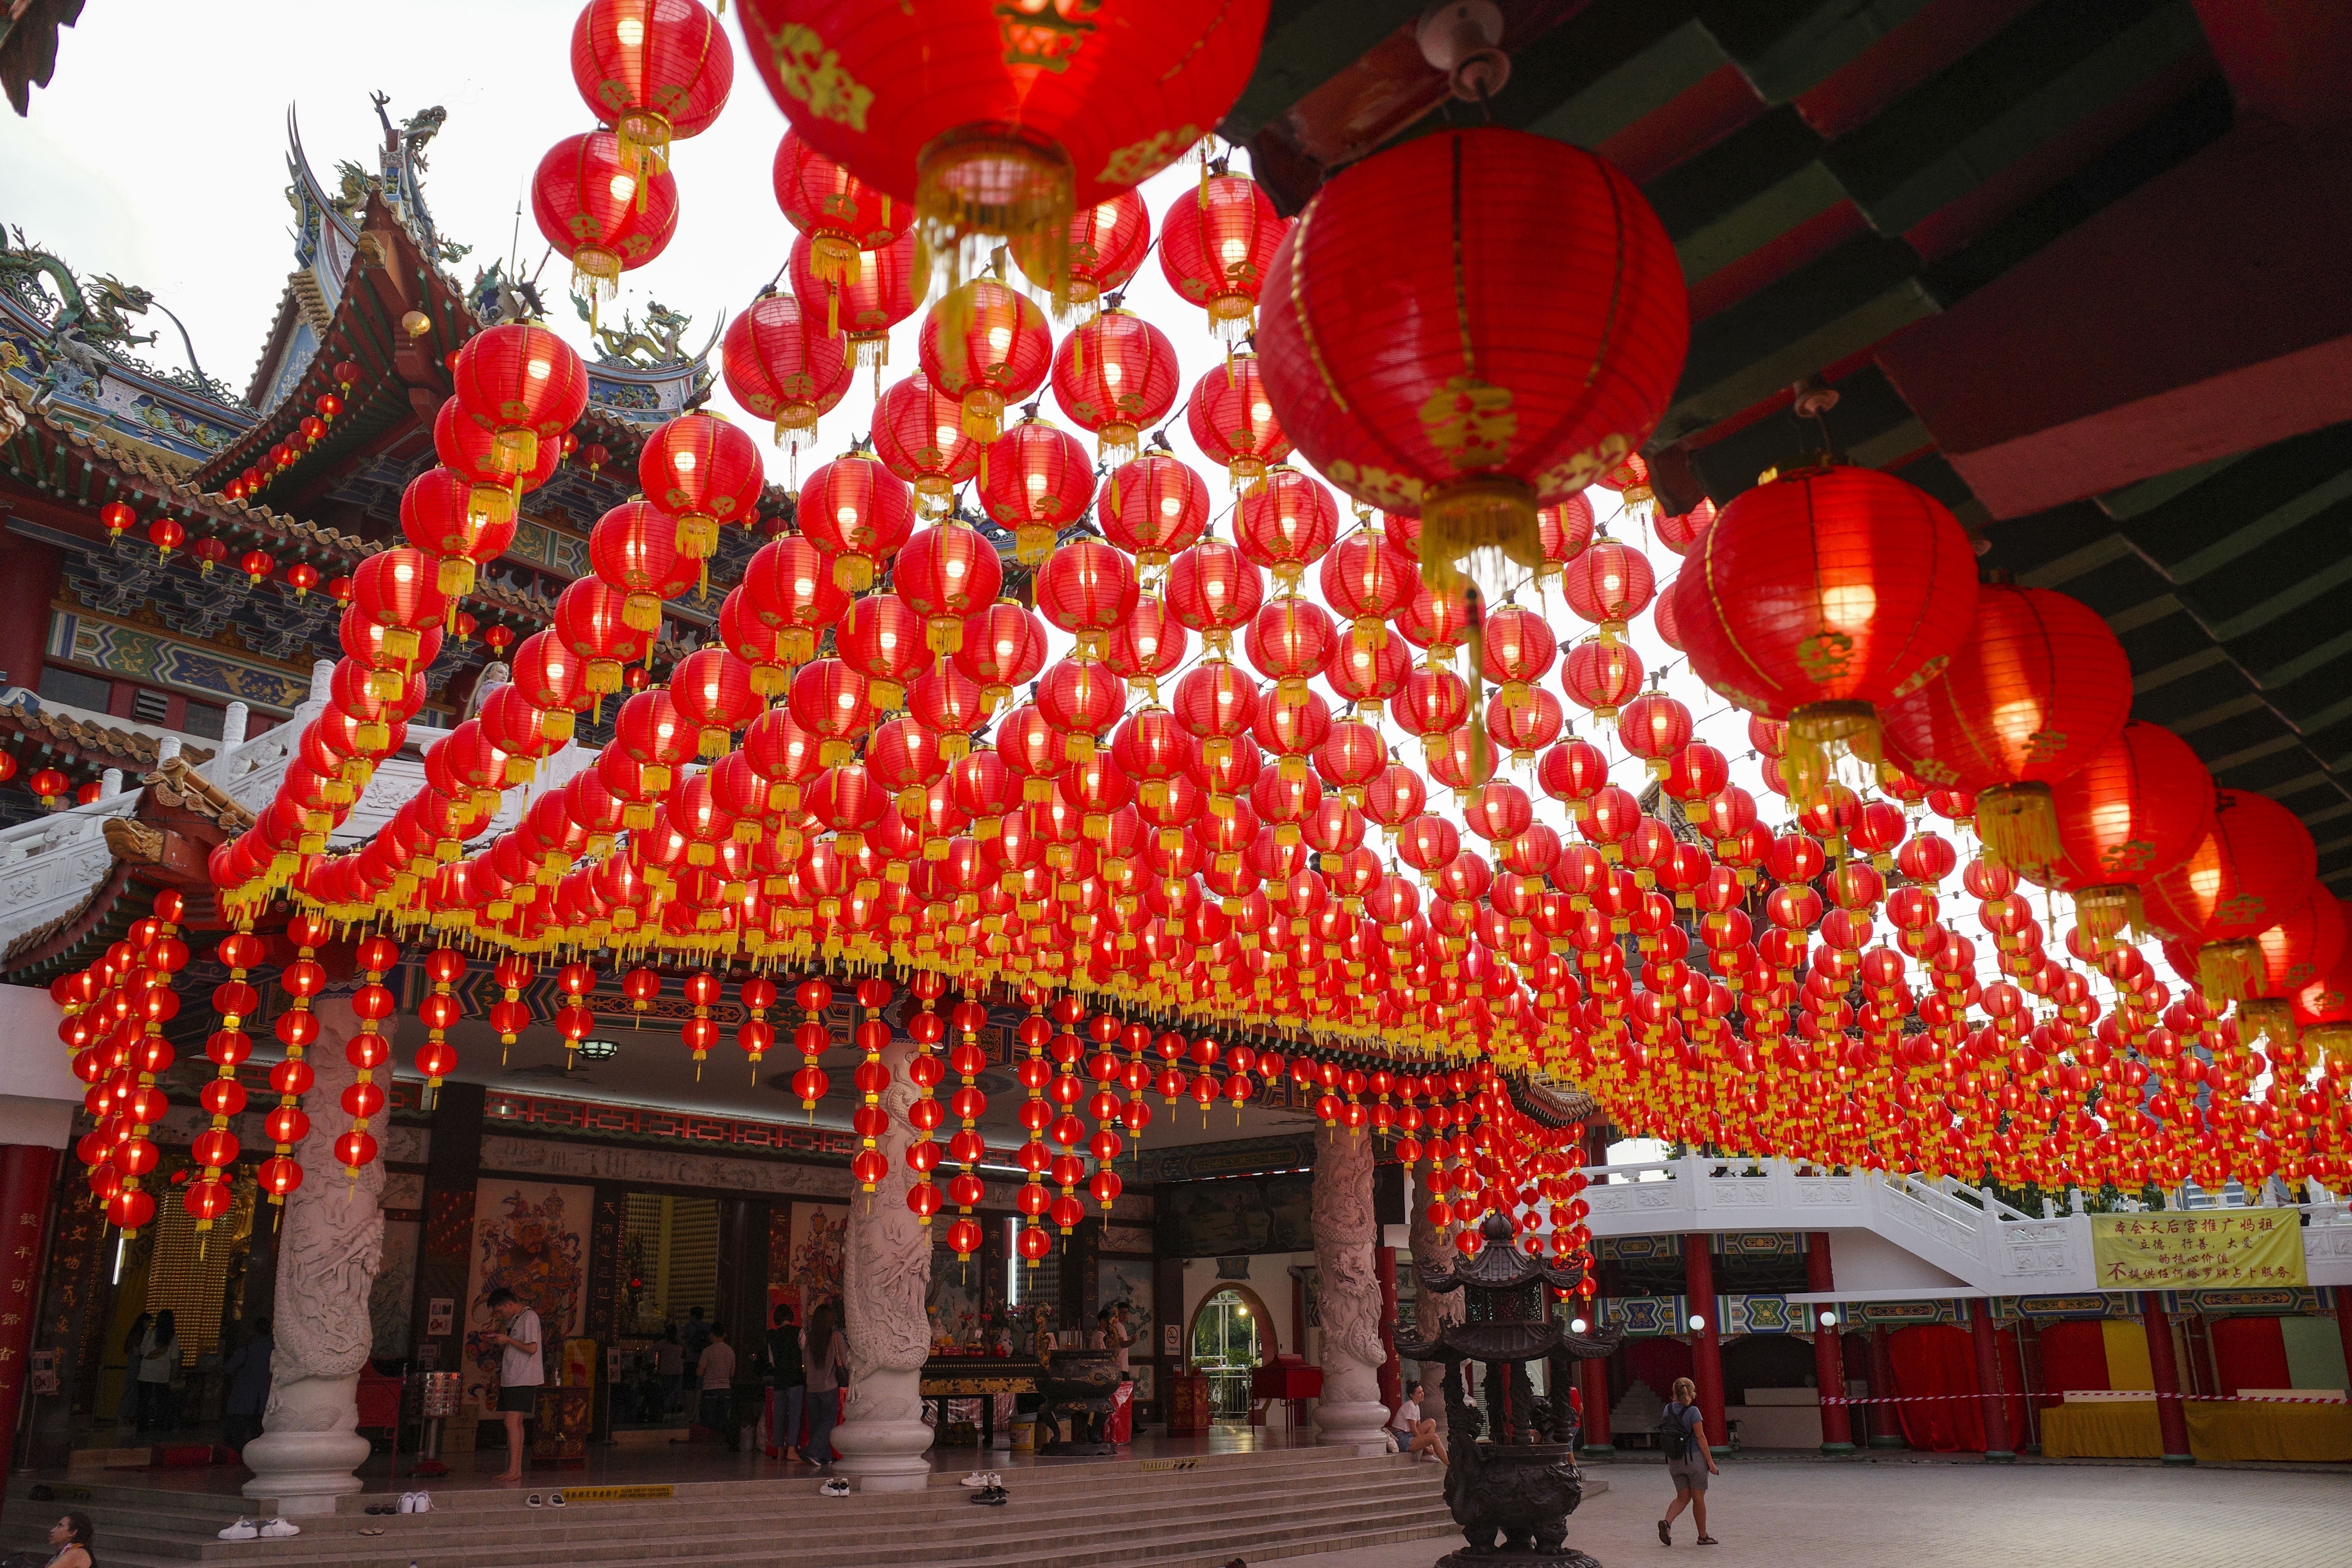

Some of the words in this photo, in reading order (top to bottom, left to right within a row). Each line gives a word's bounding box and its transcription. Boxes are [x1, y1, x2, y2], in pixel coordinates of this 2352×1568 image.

[2115, 1217, 2275, 1235] 本会天后宫推广妈祖
